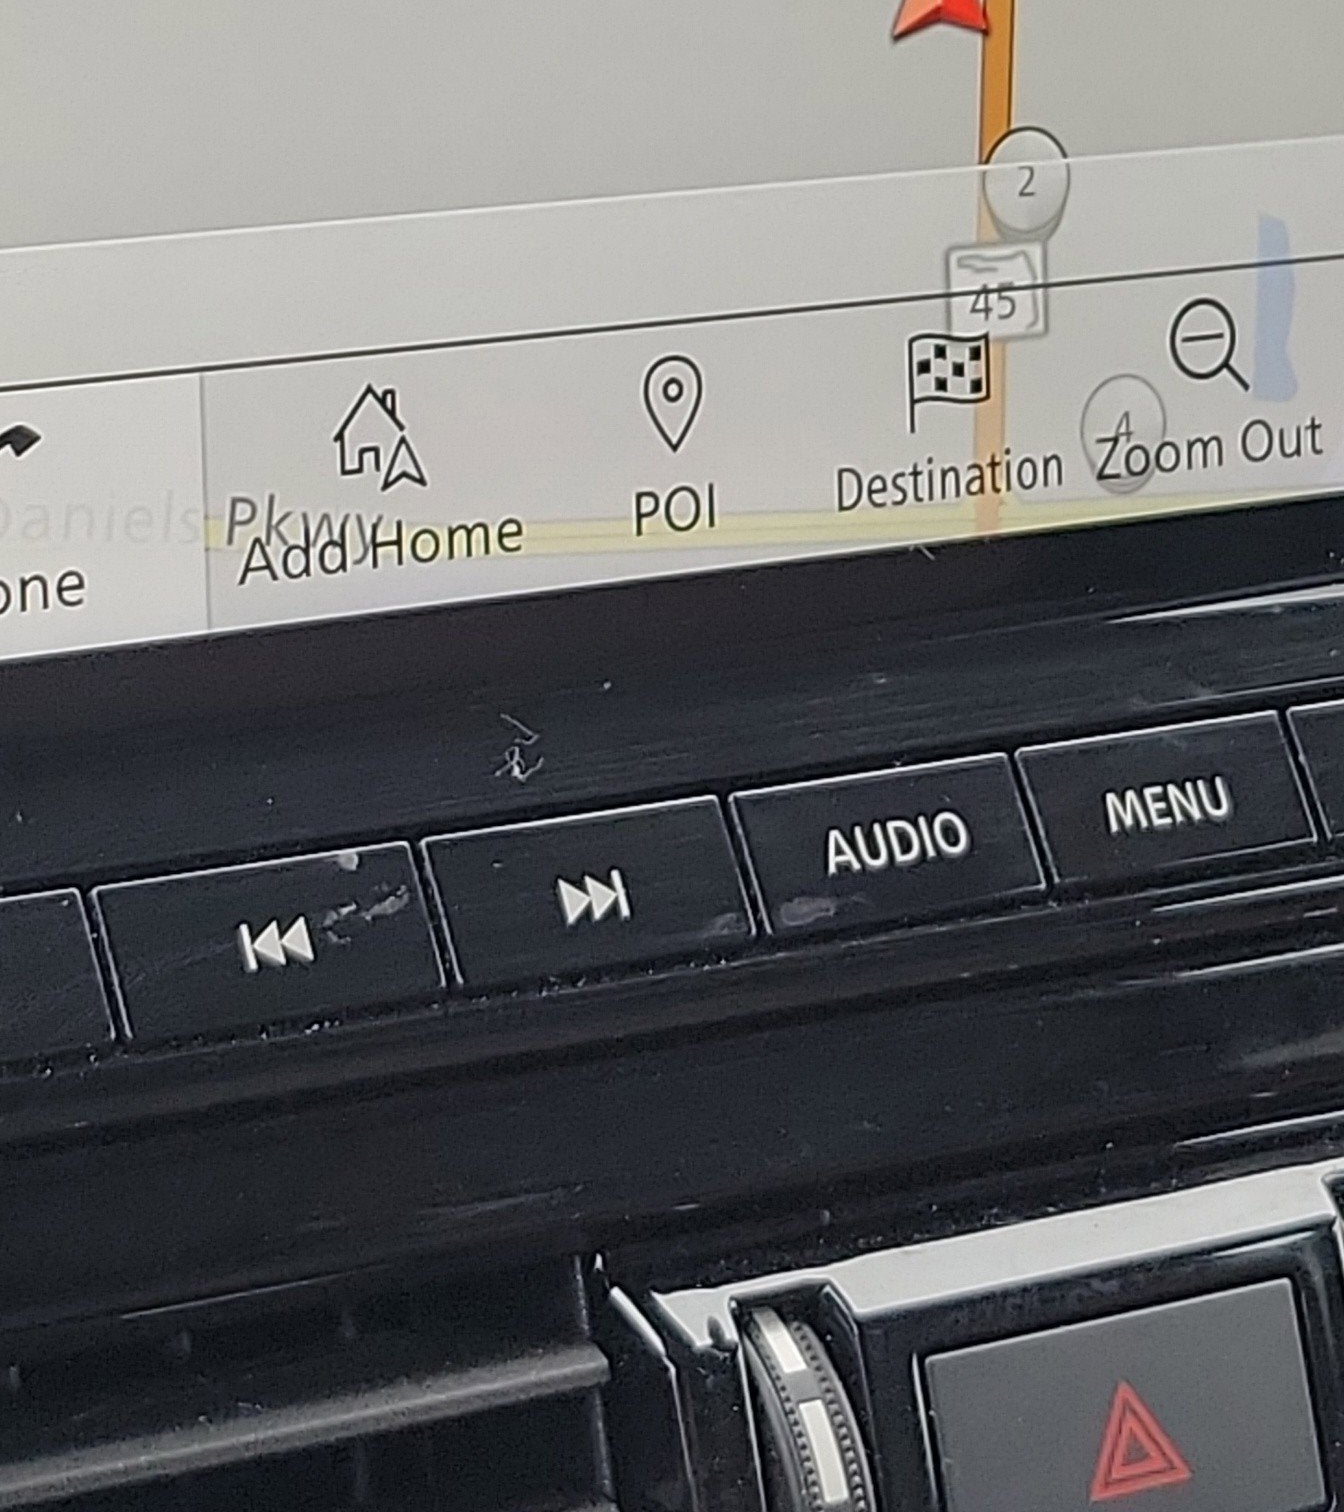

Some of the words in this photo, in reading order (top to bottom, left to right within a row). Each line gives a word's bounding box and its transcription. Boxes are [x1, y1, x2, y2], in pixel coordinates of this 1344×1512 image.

[1018, 165, 1035, 197] 2
[970, 281, 1016, 321] 45
[1095, 435, 1223, 481] Zoom
[1241, 415, 1323, 465] Out
[635, 483, 716, 537] POI
[837, 449, 1063, 512] Destination
[237, 529, 349, 586] Add
[369, 515, 524, 569] Home
[1105, 776, 1231, 835] MENU
[825, 810, 969, 877] AUDIO
